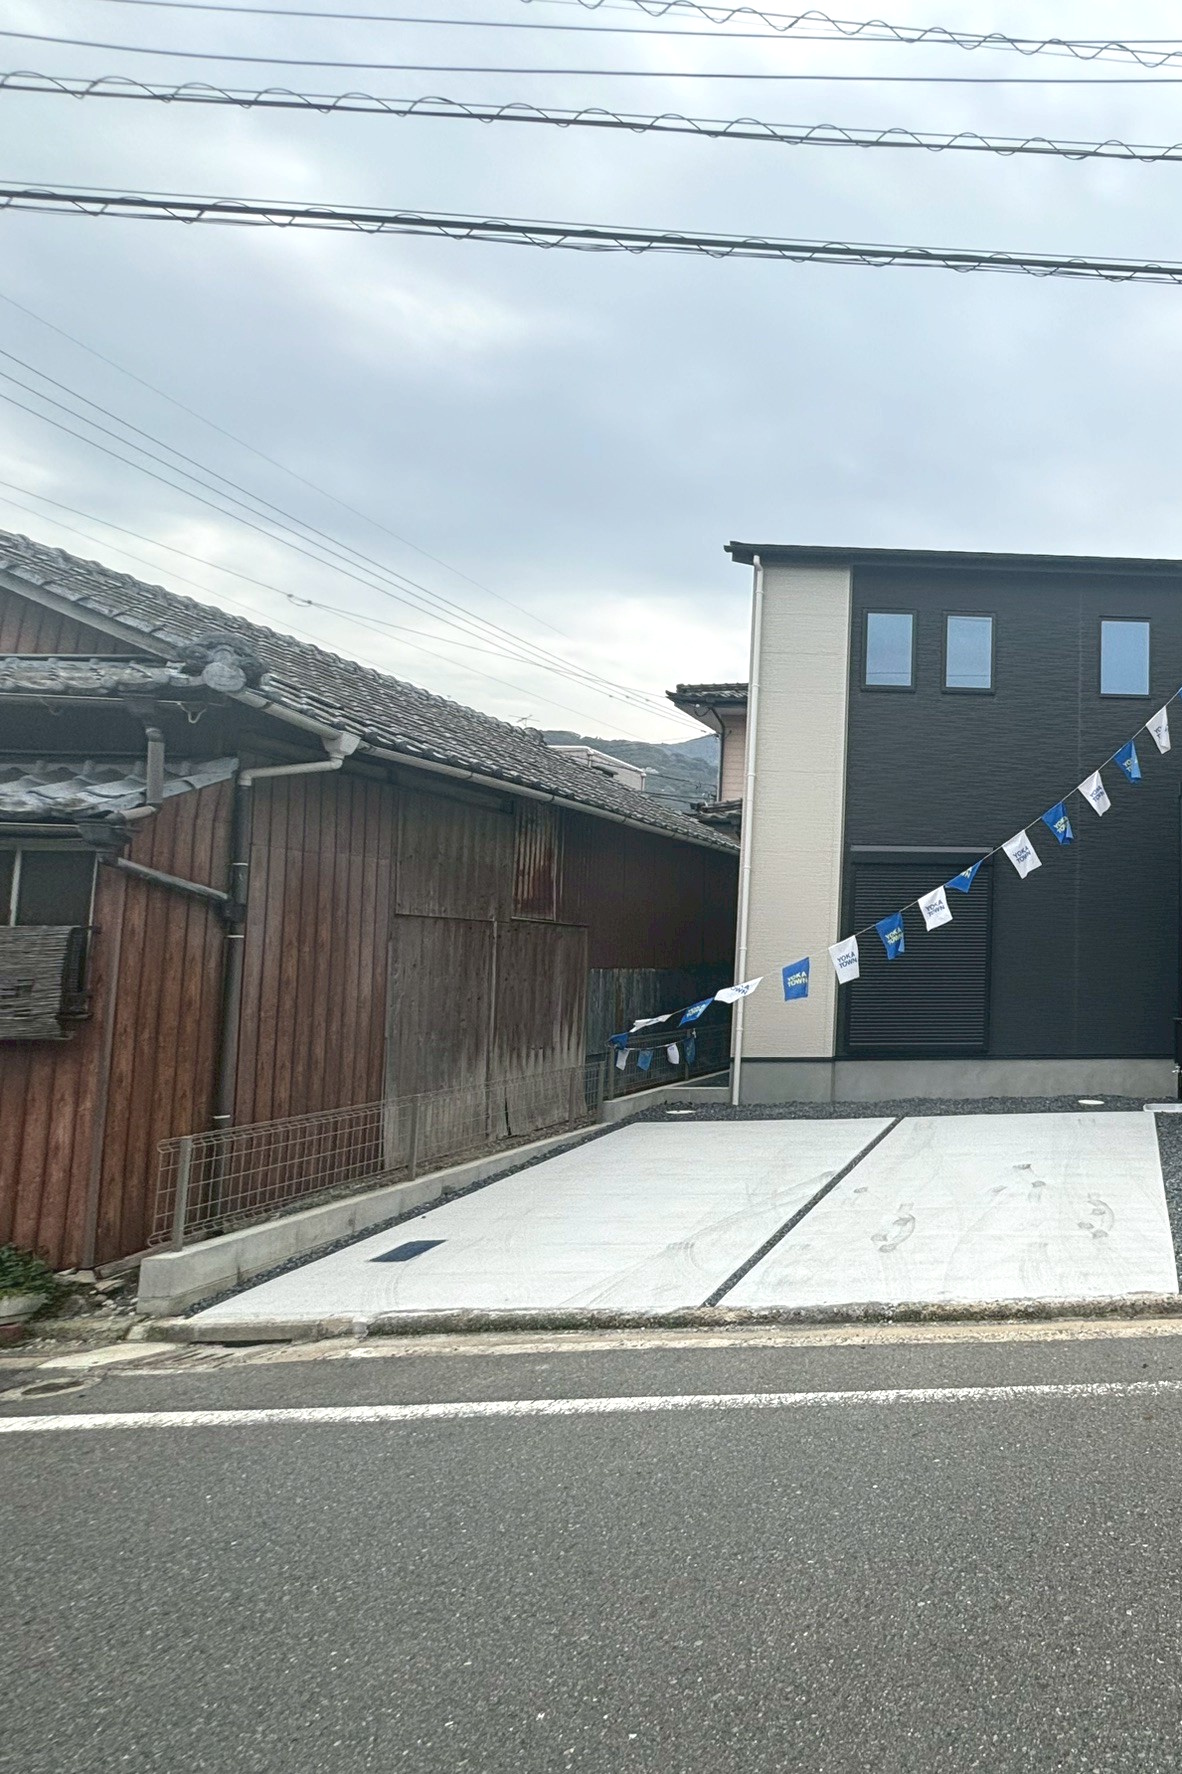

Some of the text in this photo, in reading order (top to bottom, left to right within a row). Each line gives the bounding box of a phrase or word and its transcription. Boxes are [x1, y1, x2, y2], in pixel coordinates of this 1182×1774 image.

[1013, 846, 1028, 858] YOKA
[1016, 850, 1031, 863] TOWN
[925, 900, 943, 911] YOKA
[928, 905, 945, 916] TOWN
[837, 952, 855, 962] YOKA
[839, 957, 857, 968] TOWN
[787, 971, 806, 981] YOKA
[787, 977, 808, 987] TOWN
[731, 986, 748, 995] OWN
